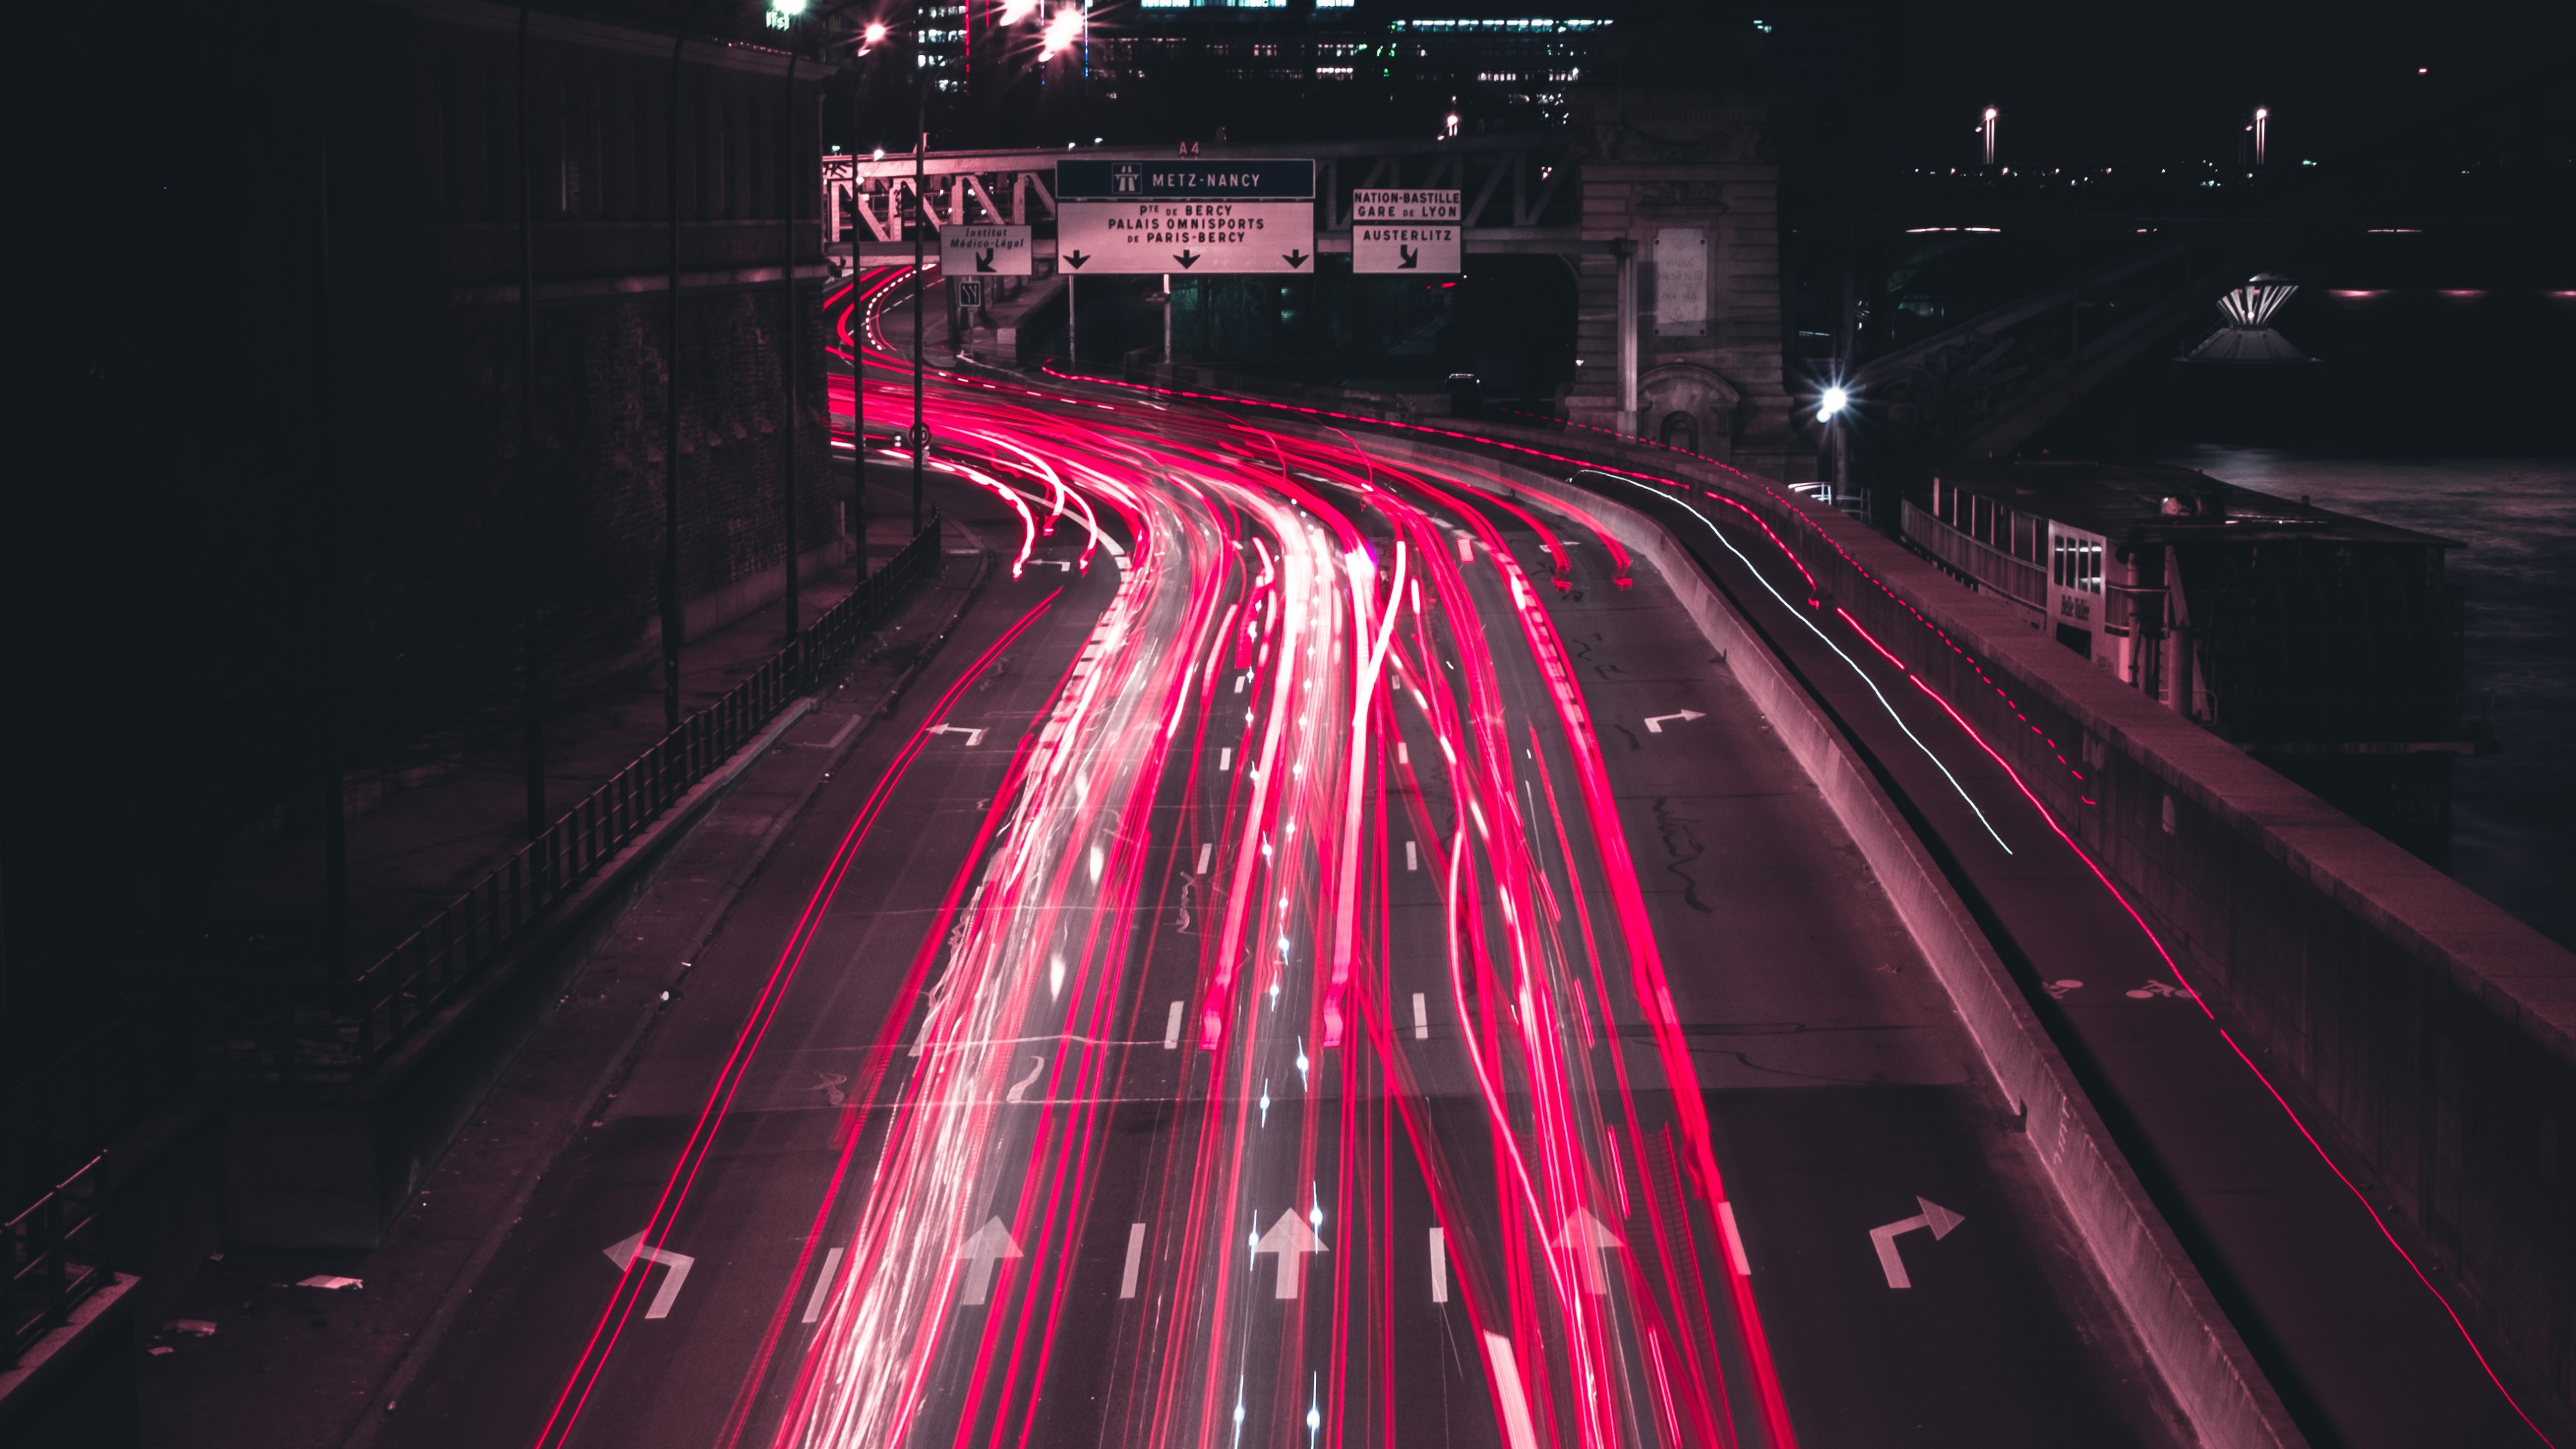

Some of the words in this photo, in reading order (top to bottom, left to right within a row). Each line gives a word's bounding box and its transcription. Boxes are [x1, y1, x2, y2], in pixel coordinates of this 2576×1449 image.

[1152, 174, 1260, 187] METZ-NANCY
[1354, 193, 1460, 204] NATION-BASTILLE
[1166, 208, 1177, 216] DE
[1185, 205, 1232, 216] BERCY
[1358, 206, 1395, 217] GARE
[1422, 206, 1456, 217] LYON
[1108, 219, 1160, 229] PALAIS
[1167, 219, 1264, 229] OMNISPORTS
[965, 228, 1008, 237] Institut
[1146, 232, 1245, 243] PARIS-BERCY
[1362, 230, 1452, 241] AUSTERLITZ
[950, 238, 1024, 250] Médico-Légal
